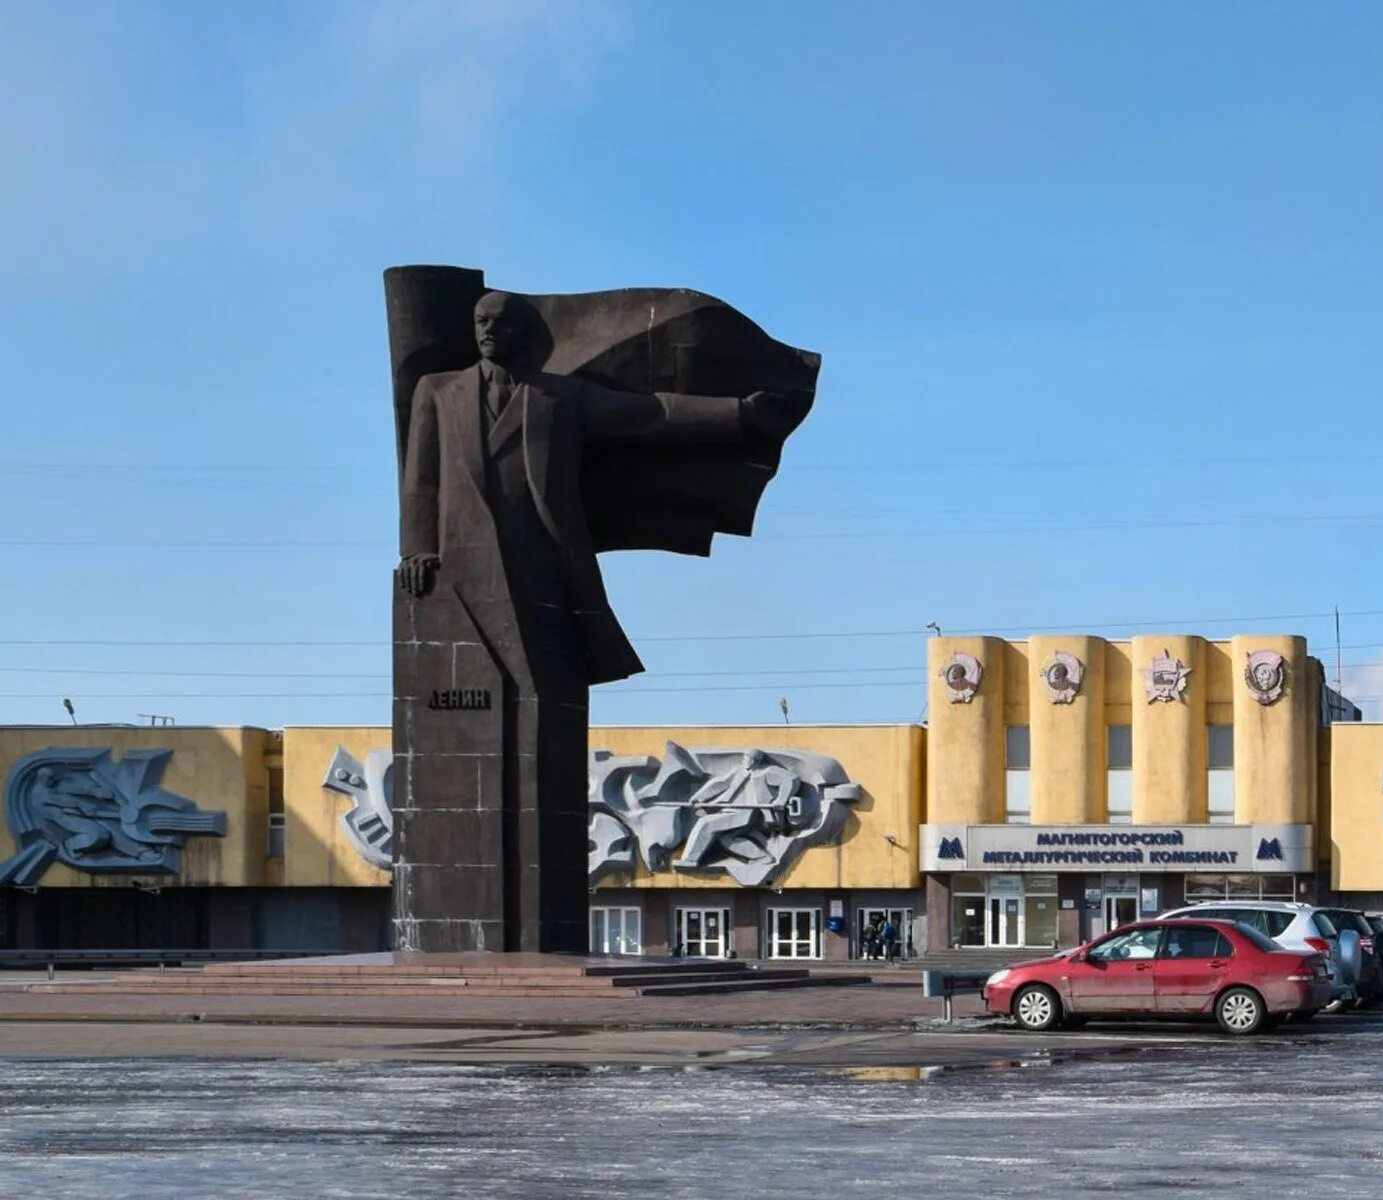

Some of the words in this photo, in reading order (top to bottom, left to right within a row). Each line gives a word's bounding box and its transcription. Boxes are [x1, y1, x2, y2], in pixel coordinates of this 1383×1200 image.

[428, 689, 491, 711] ЛЕНИН
[1036, 829, 1185, 846] МАГНИТОГОРСКИЙ
[983, 848, 1144, 864] МЕТАЛЛУРГИЧЕСКИЙ
[1149, 850, 1238, 864] КОМБИНАТ
